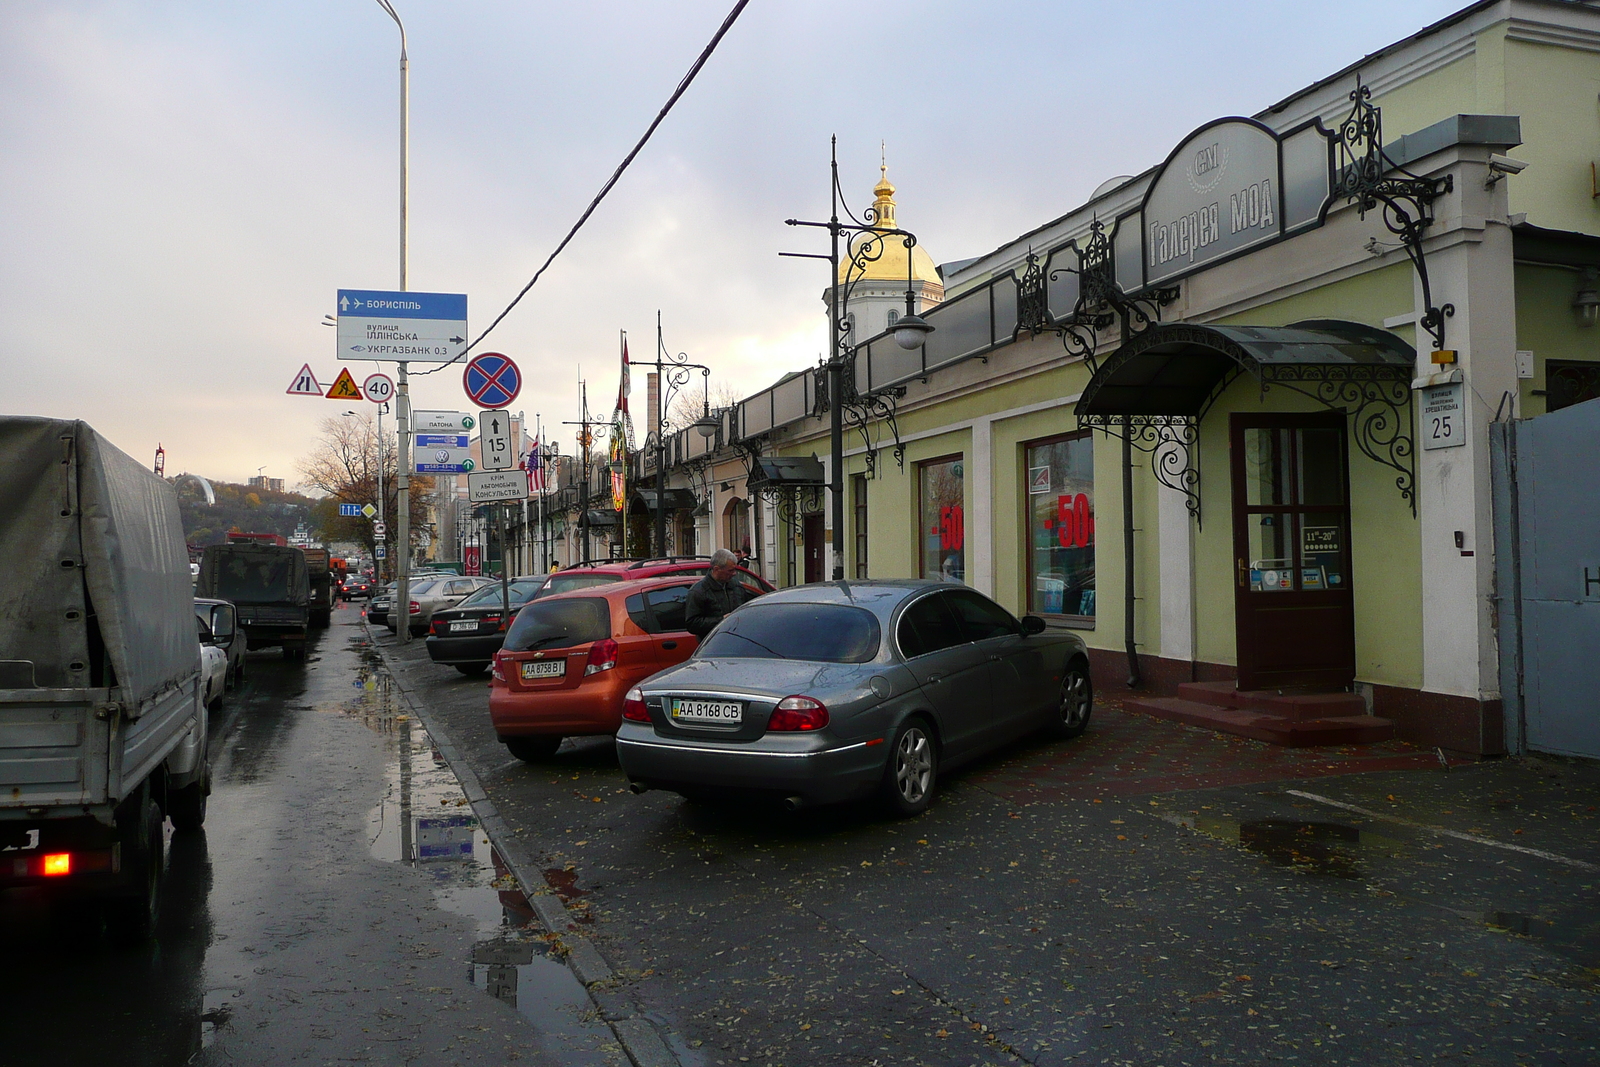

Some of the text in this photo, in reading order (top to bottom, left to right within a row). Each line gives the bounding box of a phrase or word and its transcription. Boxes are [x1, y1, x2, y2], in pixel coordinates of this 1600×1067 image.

[1194, 142, 1219, 176] GM
[1149, 178, 1274, 267] Галерея МОД
[366, 300, 421, 310] БОРИСПІЛЬ
[366, 324, 399, 332] вулиця
[366, 331, 418, 341] ІЛЛІНСЬКА
[367, 344, 431, 355] УКРГАЗБАНК
[369, 381, 389, 395] 40
[1432, 415, 1452, 439] 25
[488, 438, 506, 452] 15
[475, 489, 521, 499] КОНСУЛЬСТВА
[526, 664, 536, 675] AA
[536, 663, 552, 674] 8758
[679, 702, 739, 719] AA 8168 CB
